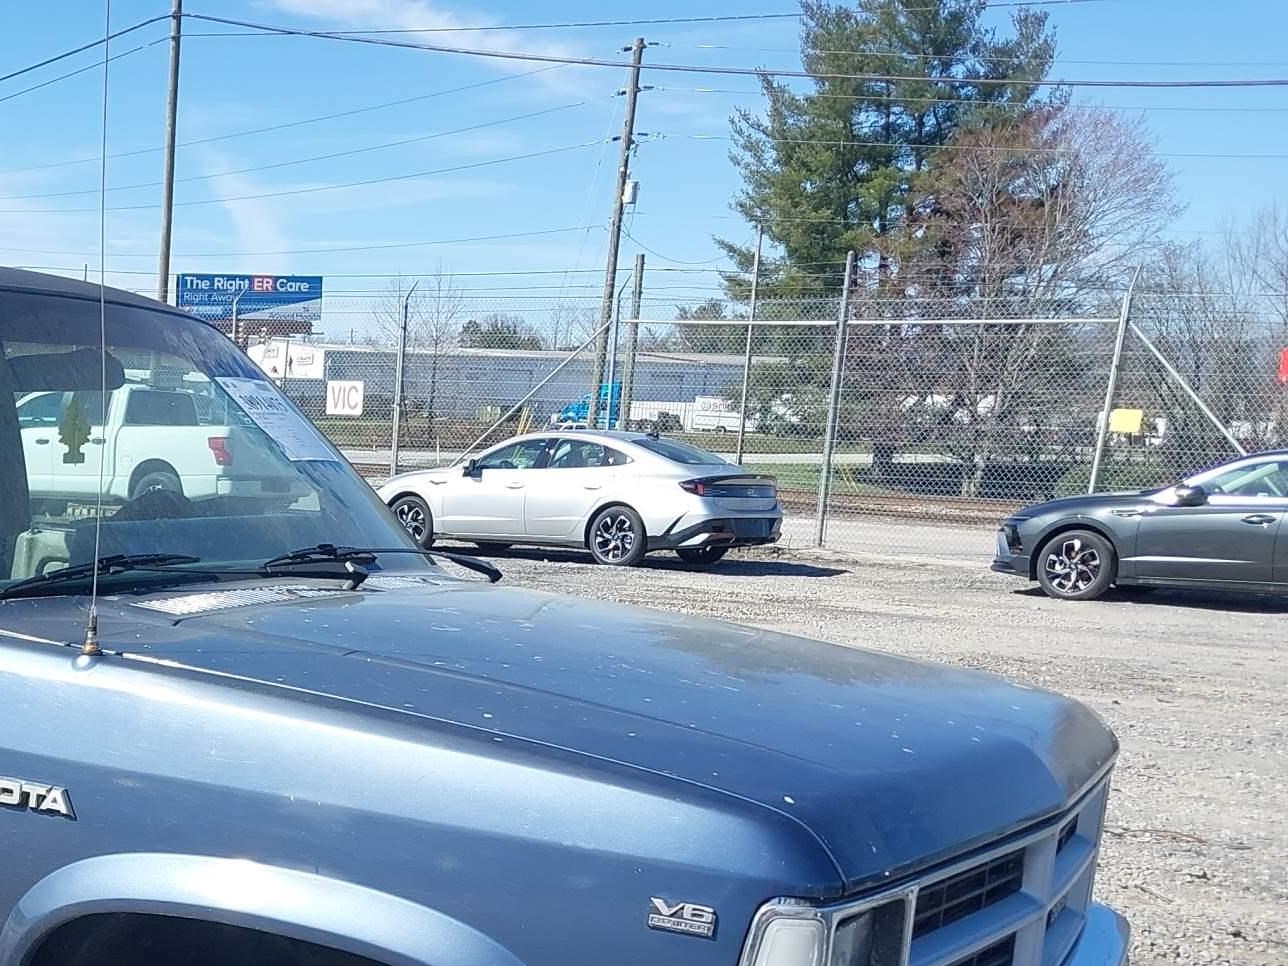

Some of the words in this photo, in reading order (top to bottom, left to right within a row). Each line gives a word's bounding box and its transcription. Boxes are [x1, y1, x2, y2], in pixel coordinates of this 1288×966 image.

[184, 277, 210, 290] The
[213, 278, 249, 292] Right
[253, 278, 274, 291] ER
[276, 279, 310, 292] Care
[183, 292, 209, 304] Right
[211, 293, 238, 304] Away
[331, 385, 359, 410] VIC
[650, 896, 716, 923] V6
